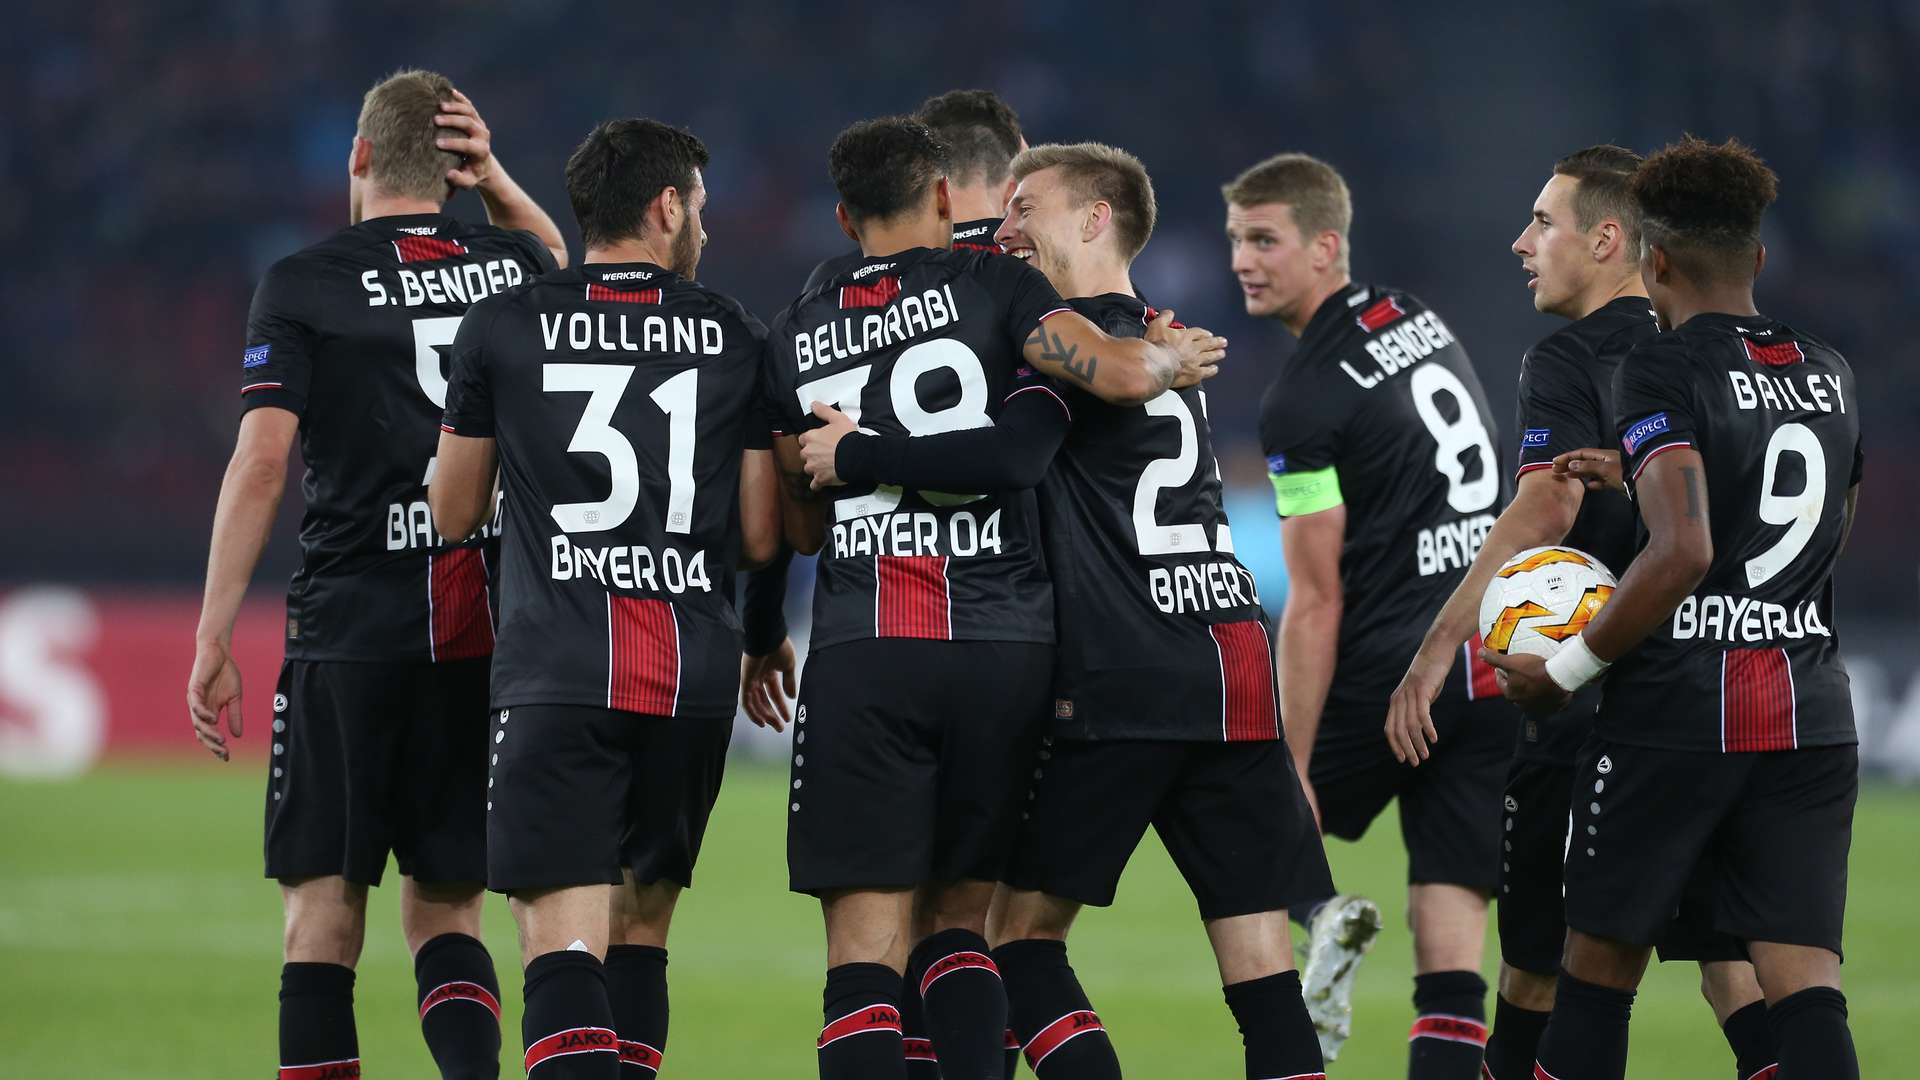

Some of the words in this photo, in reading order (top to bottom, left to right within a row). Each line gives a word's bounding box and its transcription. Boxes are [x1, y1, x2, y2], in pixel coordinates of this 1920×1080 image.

[397, 227, 438, 236] RKSELF
[952, 226, 988, 240] RKSELF
[361, 269, 398, 307] S.
[399, 258, 523, 307] BENDER
[602, 271, 653, 281] WERKSELF
[539, 312, 724, 355] VOLLAND
[795, 283, 960, 373] BELLARABI
[1339, 360, 1385, 389] L.
[1364, 309, 1455, 376] BENDER
[243, 350, 268, 364] SPECT
[1728, 370, 1846, 415] BAILEY
[542, 363, 699, 535] 31
[1410, 362, 1499, 514] 8
[1523, 431, 1549, 443] PECT
[1629, 416, 1668, 446] RESPECT
[1132, 388, 1235, 556] 2
[1744, 422, 1827, 589] 9
[831, 511, 939, 560] BAYER
[949, 507, 1002, 557] 04
[550, 534, 660, 591] BAYER
[662, 547, 712, 594] 04
[1149, 562, 1251, 614] BAYER
[1672, 594, 1786, 642] BAYER
[556, 1033, 613, 1049] JAKO
[866, 1012, 903, 1026] JAK
